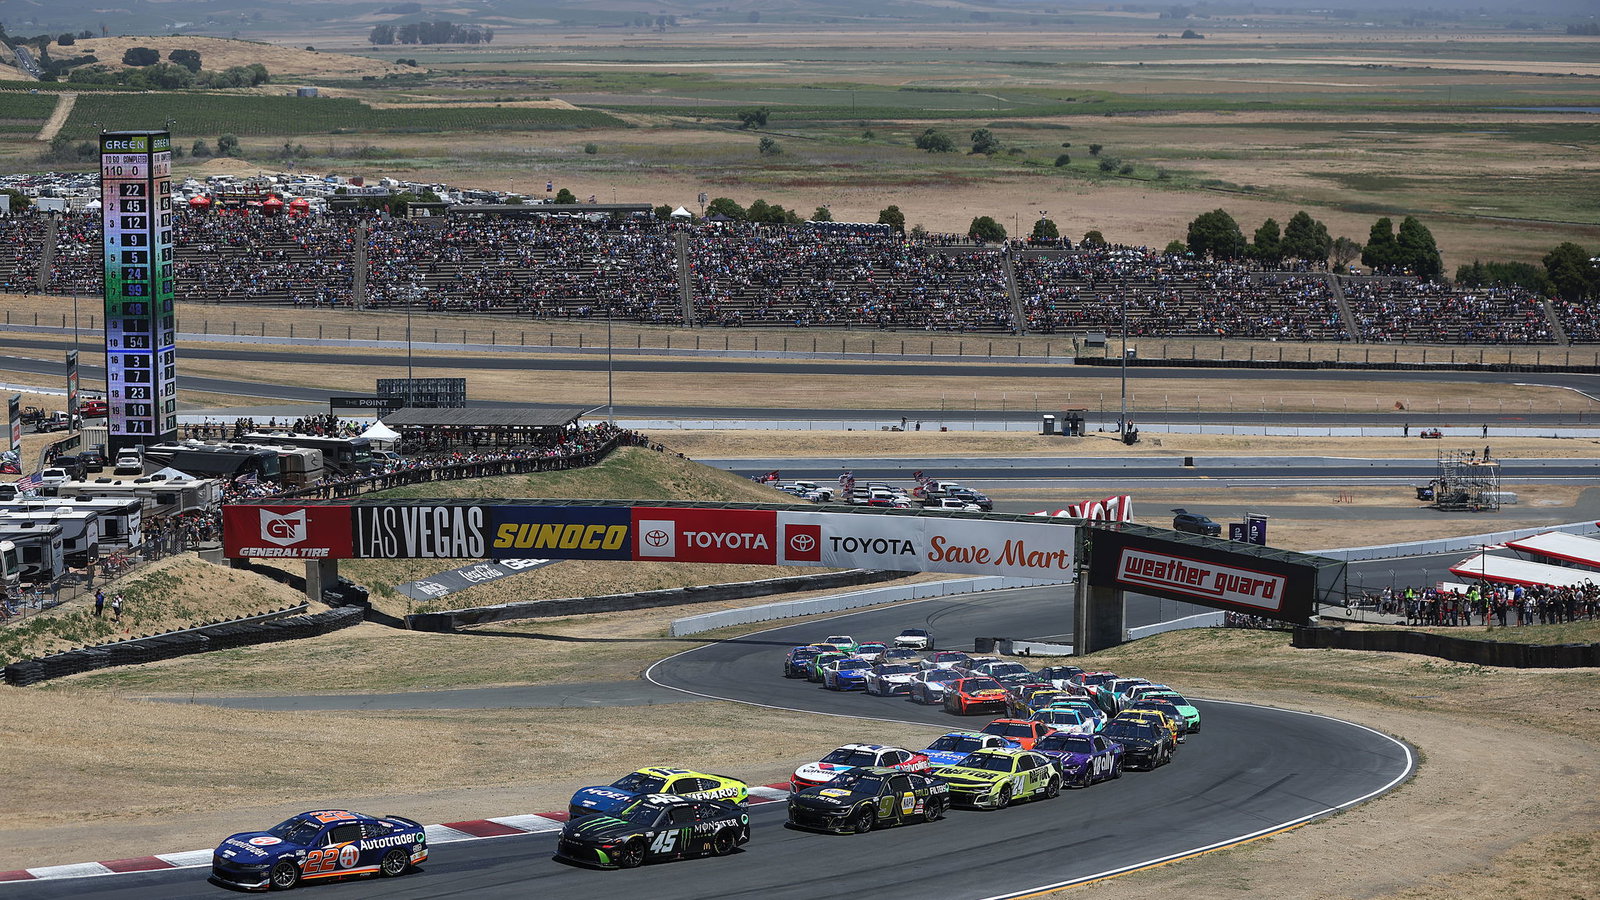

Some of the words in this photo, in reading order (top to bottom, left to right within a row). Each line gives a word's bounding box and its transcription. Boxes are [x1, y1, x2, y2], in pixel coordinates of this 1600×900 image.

[105, 140, 144, 149] GREEN
[104, 166, 123, 176] 110
[131, 166, 139, 176] 0
[126, 184, 139, 196] 22
[162, 182, 169, 193] 22
[109, 203, 114, 211] 2
[126, 201, 140, 212] 45
[109, 220, 115, 228] 3
[127, 217, 140, 228] 12
[109, 237, 115, 245] 4
[131, 235, 137, 246] 9
[110, 254, 116, 262] 5
[131, 252, 138, 263] 5
[111, 271, 116, 279] 6
[127, 269, 141, 279] 24
[128, 285, 142, 295] 99
[133, 320, 138, 331] 1
[110, 339, 118, 347] 10
[130, 337, 143, 347] 54
[110, 355, 118, 364] 16
[133, 356, 140, 367] 3
[110, 373, 119, 381] 17
[134, 371, 140, 382] 7
[111, 390, 119, 398] 18
[131, 388, 144, 399] 23
[166, 383, 173, 395] 23
[112, 407, 120, 415] 19
[132, 405, 144, 416] 10
[111, 424, 120, 432] 20
[132, 421, 145, 432] 71
[357, 506, 397, 558] LAS
[401, 506, 485, 558] VEGAS
[492, 523, 628, 550] SUNOCO
[1250, 525, 1259, 542] ally
[683, 531, 769, 550] TOYOTA
[829, 536, 916, 555] TOYOTA
[239, 547, 299, 557] GENERAL
[300, 547, 330, 557] TIRE
[927, 535, 991, 564] Save
[994, 539, 1070, 569] Mart
[1124, 555, 1210, 586] weather
[1214, 573, 1278, 599] guard
[1101, 751, 1114, 774] ally
[1029, 765, 1050, 784] RAPTOR
[1012, 774, 1025, 795] 24
[816, 795, 842, 805] FILTERS
[903, 796, 915, 808] NAPA
[877, 795, 895, 818] 9
[694, 819, 739, 833] MONSTER
[360, 832, 415, 851] Autotrader
[650, 829, 680, 854] 45
[302, 849, 340, 874] 22
